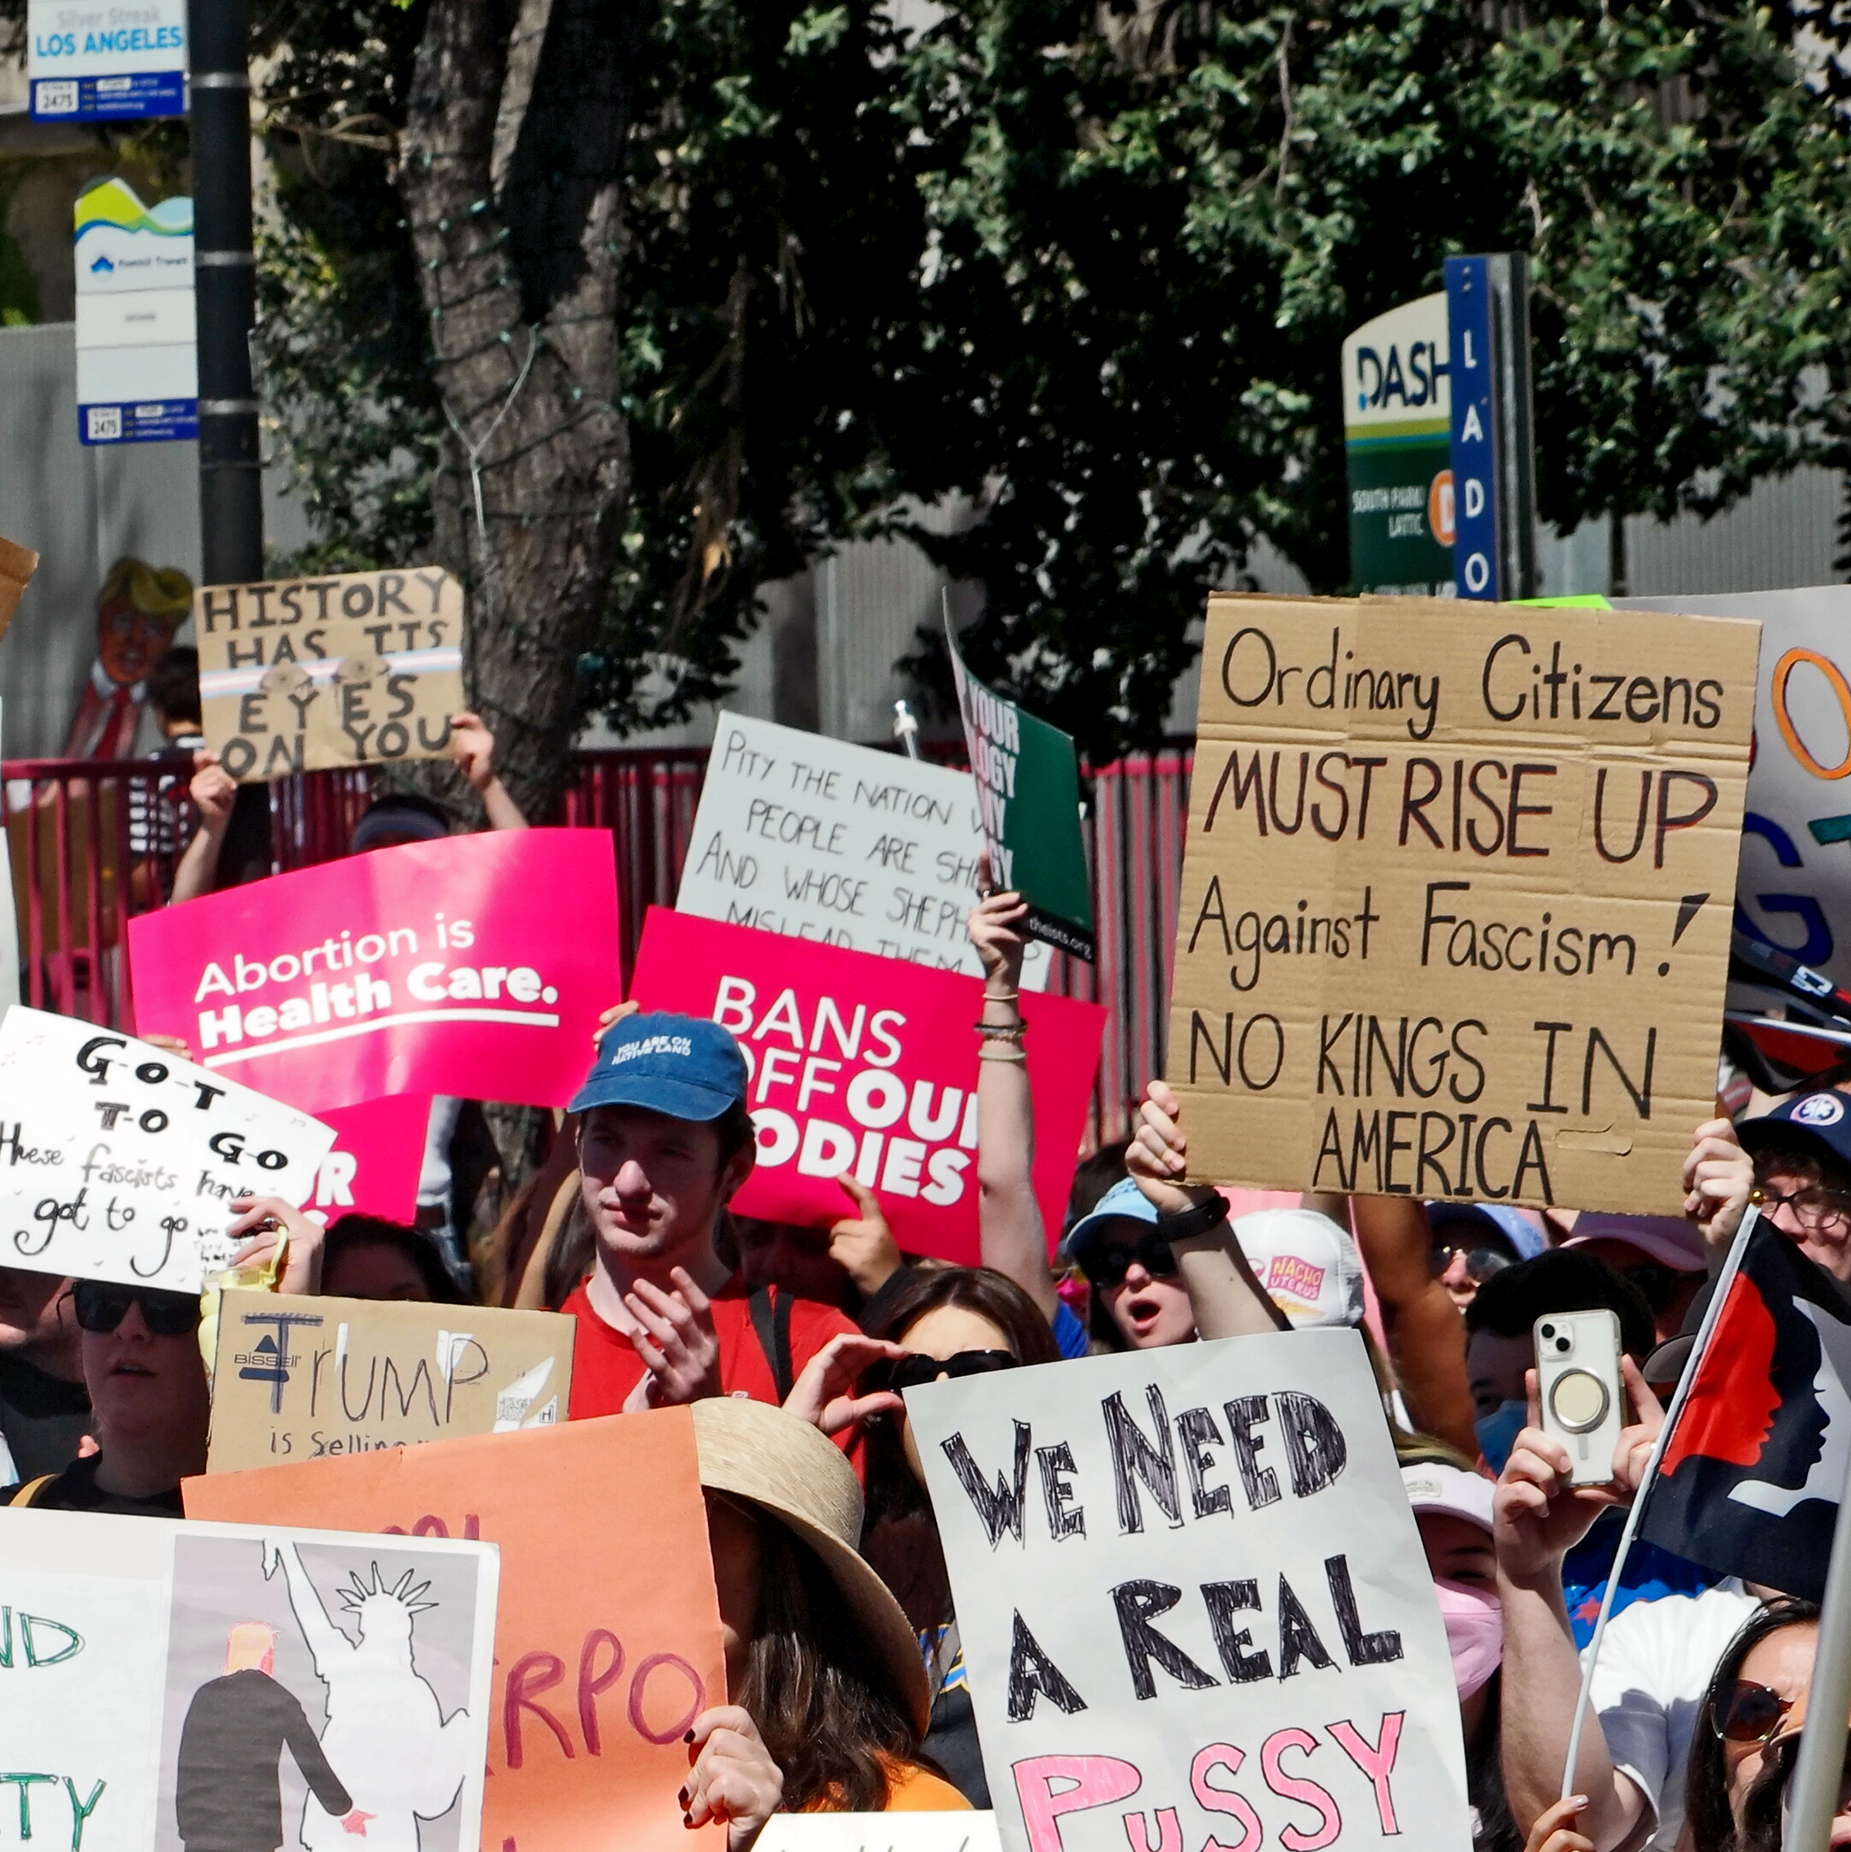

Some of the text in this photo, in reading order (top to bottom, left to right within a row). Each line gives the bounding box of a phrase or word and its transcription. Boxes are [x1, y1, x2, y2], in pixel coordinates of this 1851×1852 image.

[36, 26, 182, 57] LOS ANGELES
[203, 570, 447, 632] HISTORY
[227, 629, 329, 669] HAS
[1223, 627, 1724, 740] Ordinary Citizens
[239, 674, 419, 734] EYES
[220, 714, 453, 778] ON YOU
[791, 762, 841, 799] THE
[853, 778, 954, 827] NATION
[1203, 749, 1718, 870] MUST RISE UP
[696, 832, 866, 917] AND WHOSE
[747, 797, 918, 875] PEOPLE ARE
[196, 912, 476, 1003] Abortion is
[1187, 874, 1380, 992] Against
[198, 959, 559, 1050] Health Care.
[642, 1035, 670, 1049] ARE
[671, 1036, 692, 1047] ON
[712, 975, 906, 1069] BANS
[655, 1044, 691, 1057] LAND
[1188, 1009, 1658, 1120] NO KINGS IN
[80, 1143, 178, 1192] fascists
[1312, 1105, 1555, 1206] AMERICA
[14, 1187, 89, 1256] got
[107, 1196, 135, 1231] to
[130, 1215, 188, 1278] go
[1273, 1257, 1322, 1286] NACHO
[1271, 1276, 1317, 1299] UTERUS
[271, 1427, 292, 1455] is
[941, 1383, 1347, 1550] WE NEED
[1006, 1554, 1405, 1723] A REAL
